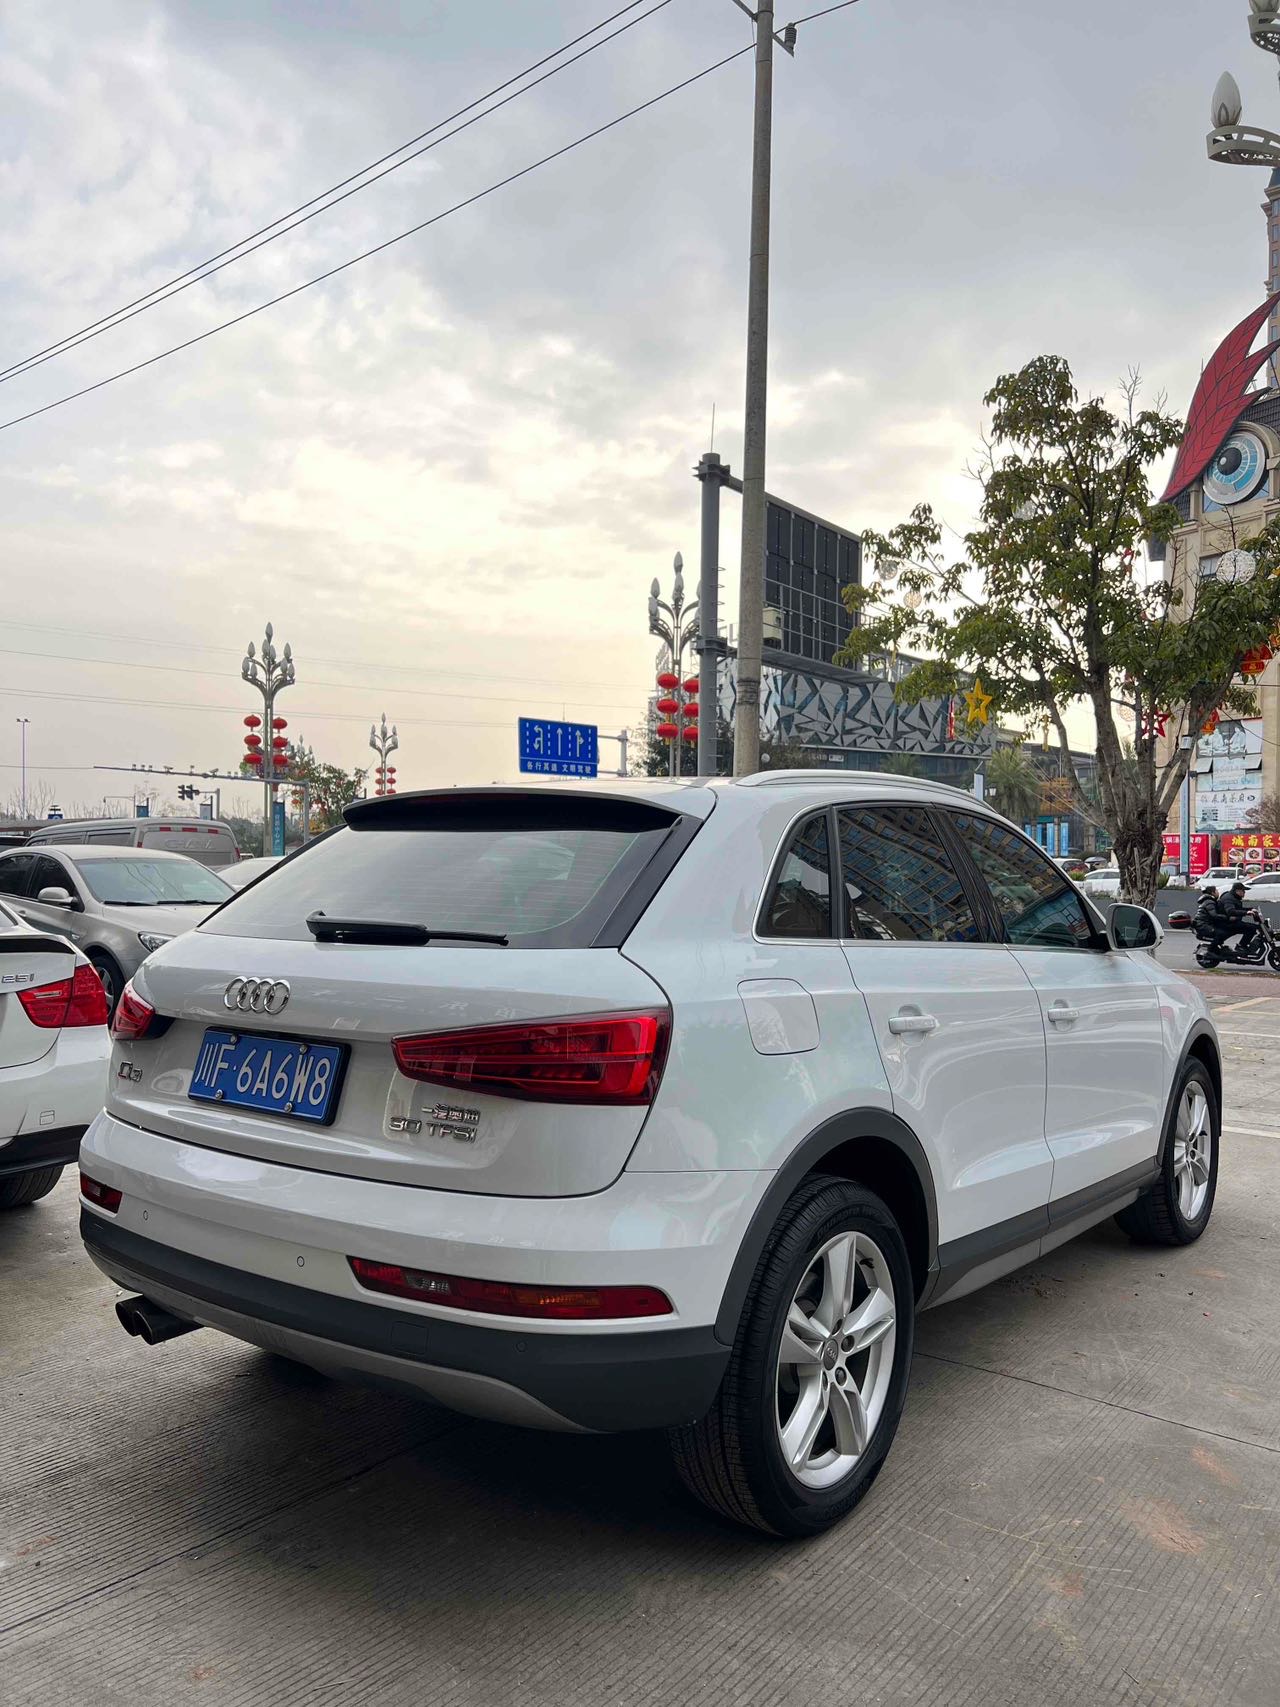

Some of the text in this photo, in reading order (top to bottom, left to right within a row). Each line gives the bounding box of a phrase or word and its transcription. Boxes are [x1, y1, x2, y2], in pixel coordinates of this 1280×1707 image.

[1231, 834, 1280, 848] 城南家
[117, 1060, 143, 1082] Q3
[421, 1103, 481, 1125] 一汽奥迪
[388, 1116, 478, 1143] 30 TFSI
